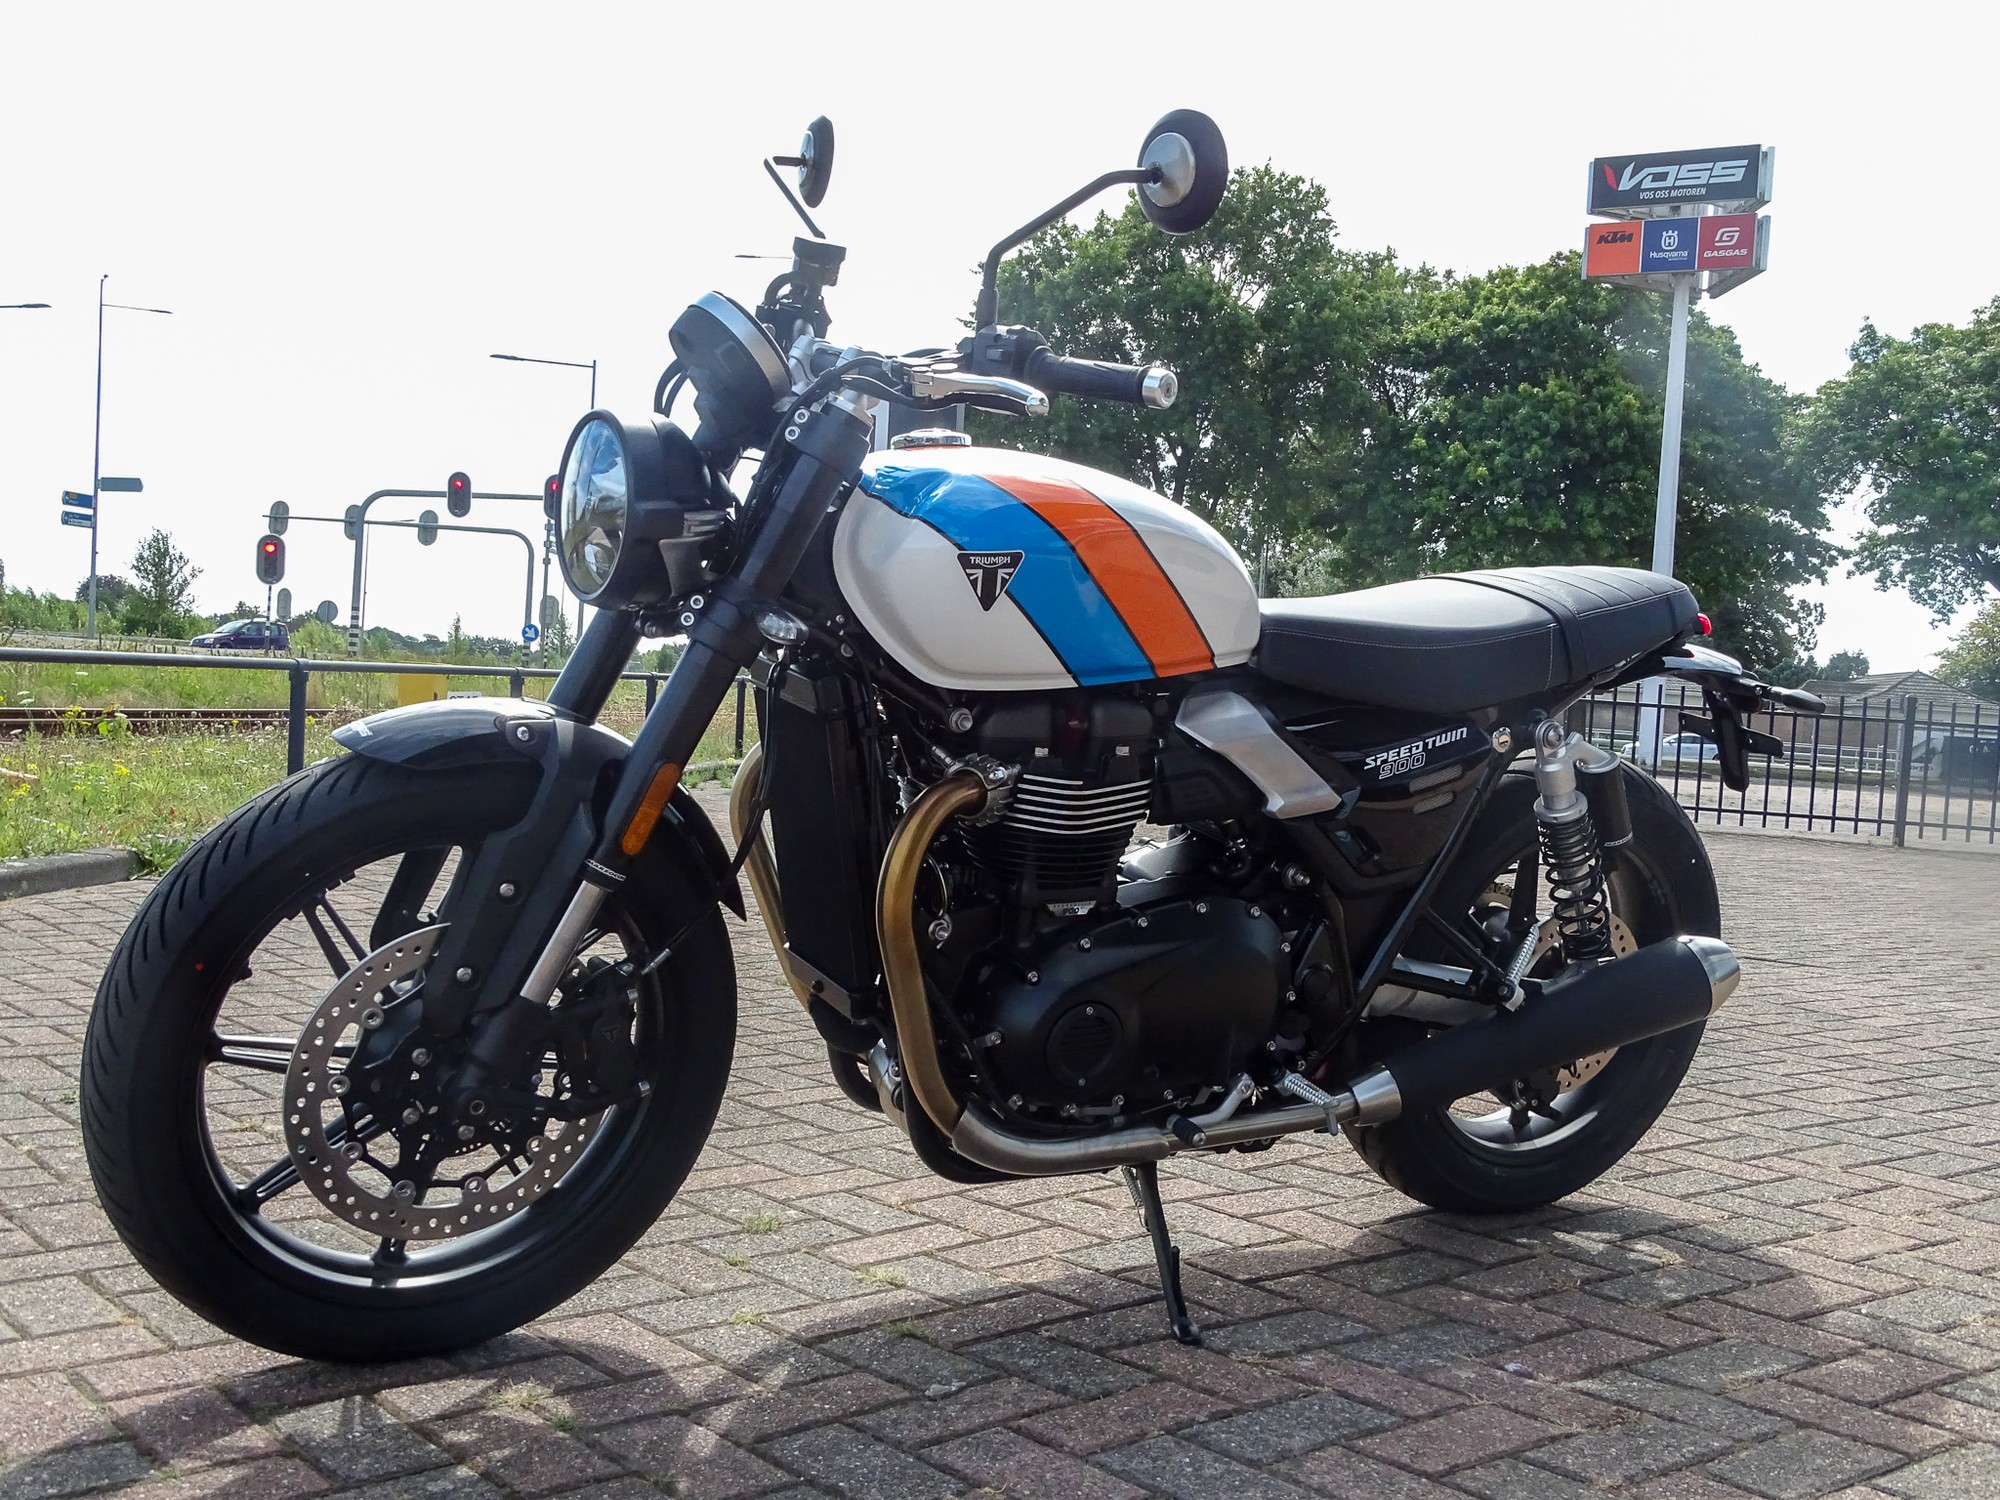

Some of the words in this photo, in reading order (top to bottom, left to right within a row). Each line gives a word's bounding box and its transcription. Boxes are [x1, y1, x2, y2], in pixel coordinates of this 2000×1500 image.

[1616, 159, 1749, 191] VOSS
[1639, 191, 1654, 199] VOS
[1655, 190, 1670, 199] OSS
[1670, 187, 1707, 197] MOTOREN
[1596, 230, 1634, 244] KTM
[1649, 251, 1688, 259] Husqvarna
[1703, 248, 1748, 258] GASGAS
[969, 555, 1011, 566] TRIUMPH
[1364, 741, 1423, 770] SPEED
[1425, 727, 1467, 749] TWIN
[1379, 752, 1425, 780] 900
